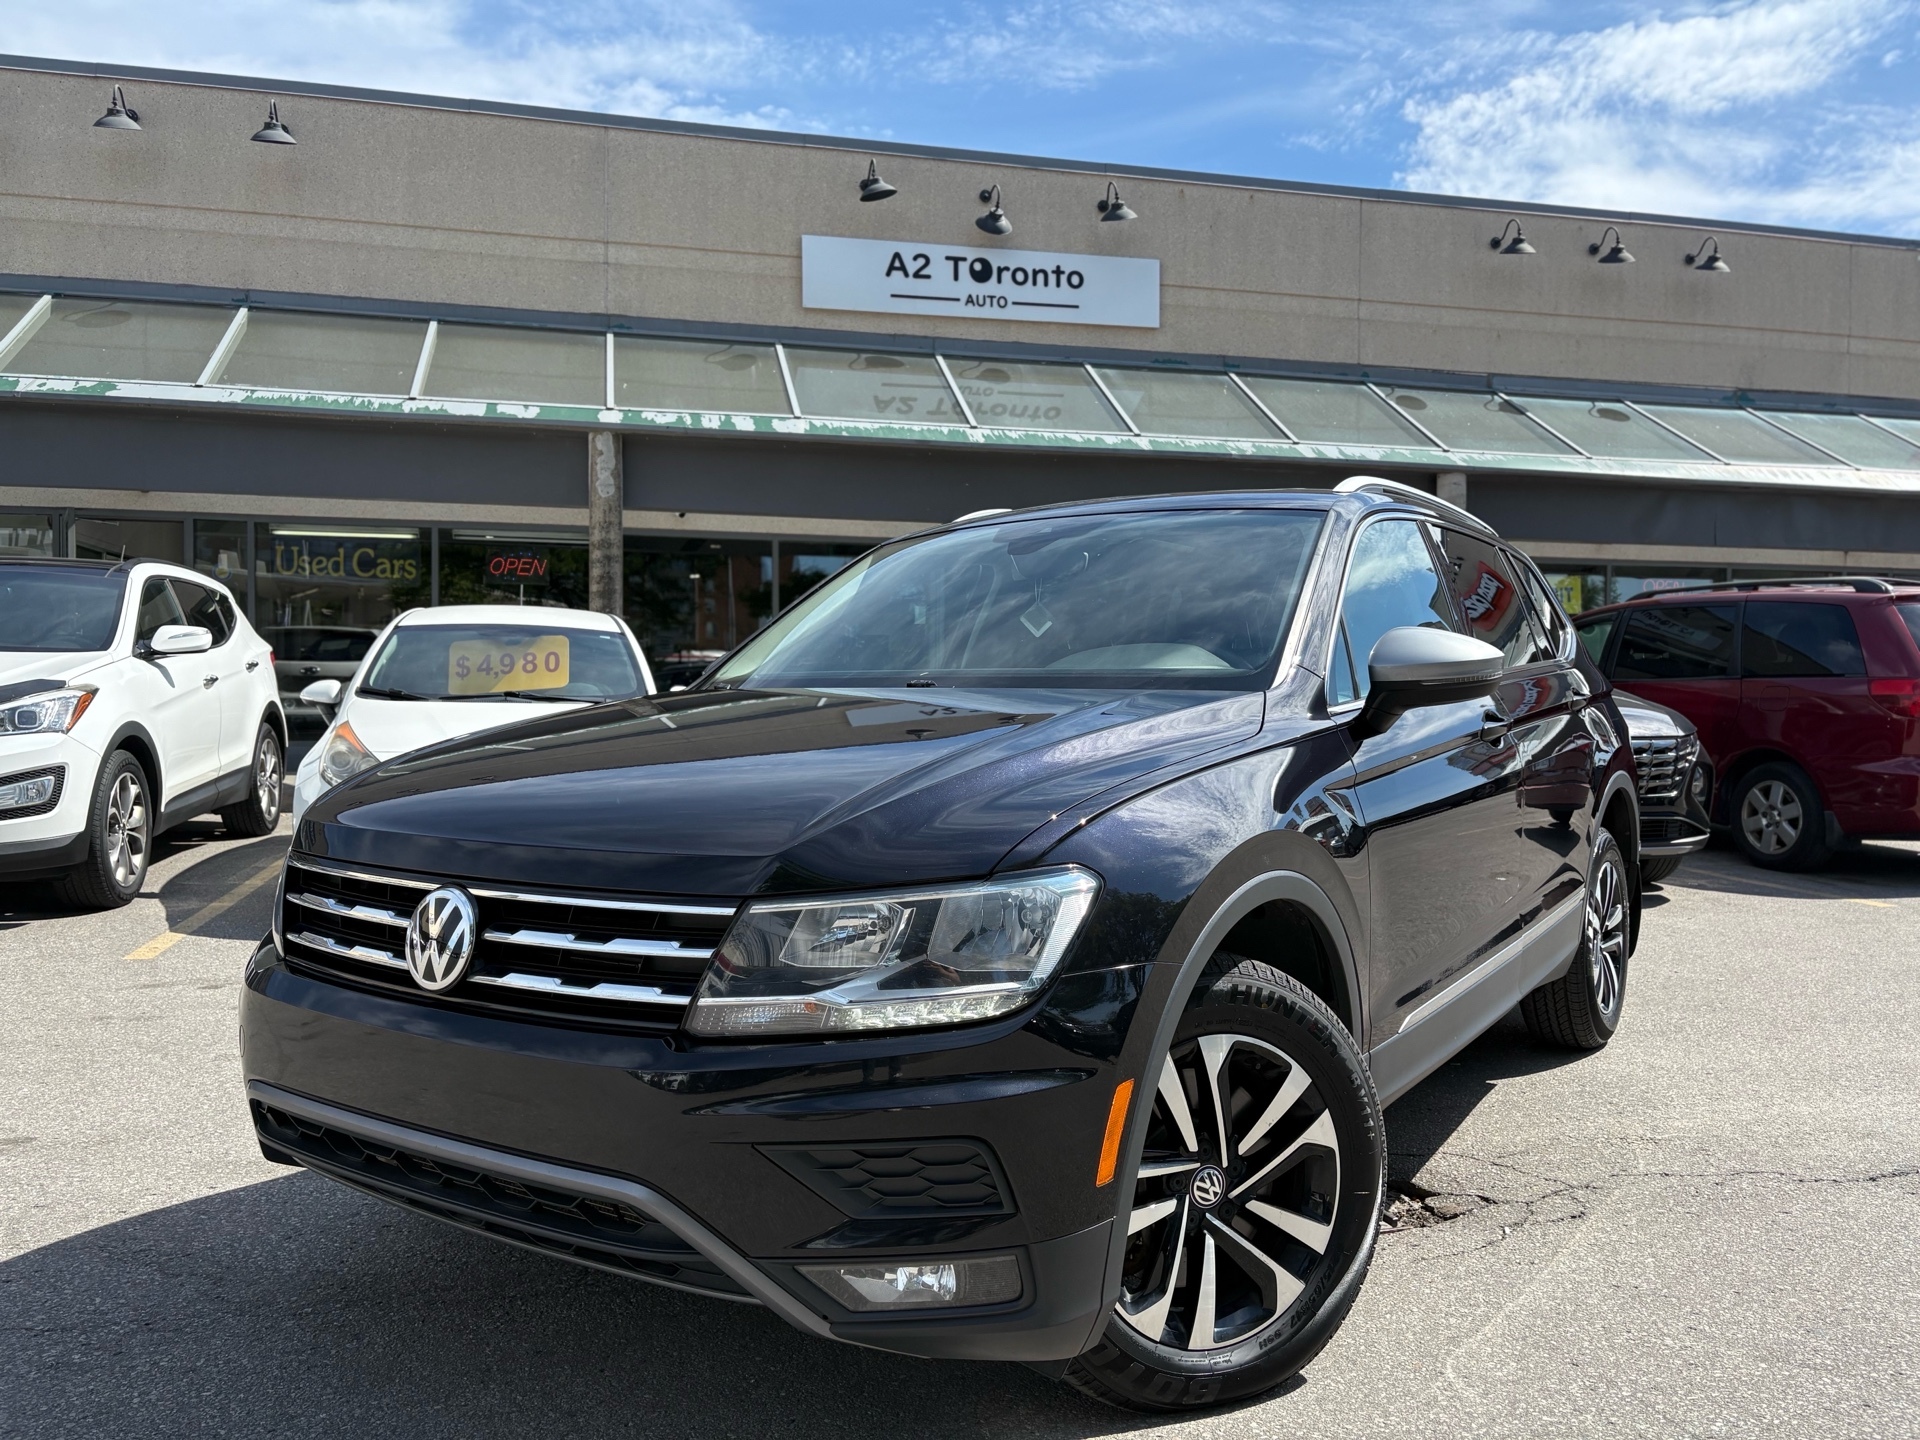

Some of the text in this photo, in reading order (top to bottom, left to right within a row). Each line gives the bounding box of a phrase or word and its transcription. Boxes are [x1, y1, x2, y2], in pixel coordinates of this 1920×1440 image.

[885, 251, 1085, 290] A2 Toronto
[965, 294, 1008, 309] AUTO
[275, 545, 417, 580] Used Cars
[489, 557, 548, 576] OPEN
[455, 651, 560, 680] $4,980
[1226, 983, 1340, 1059] HUNTER
